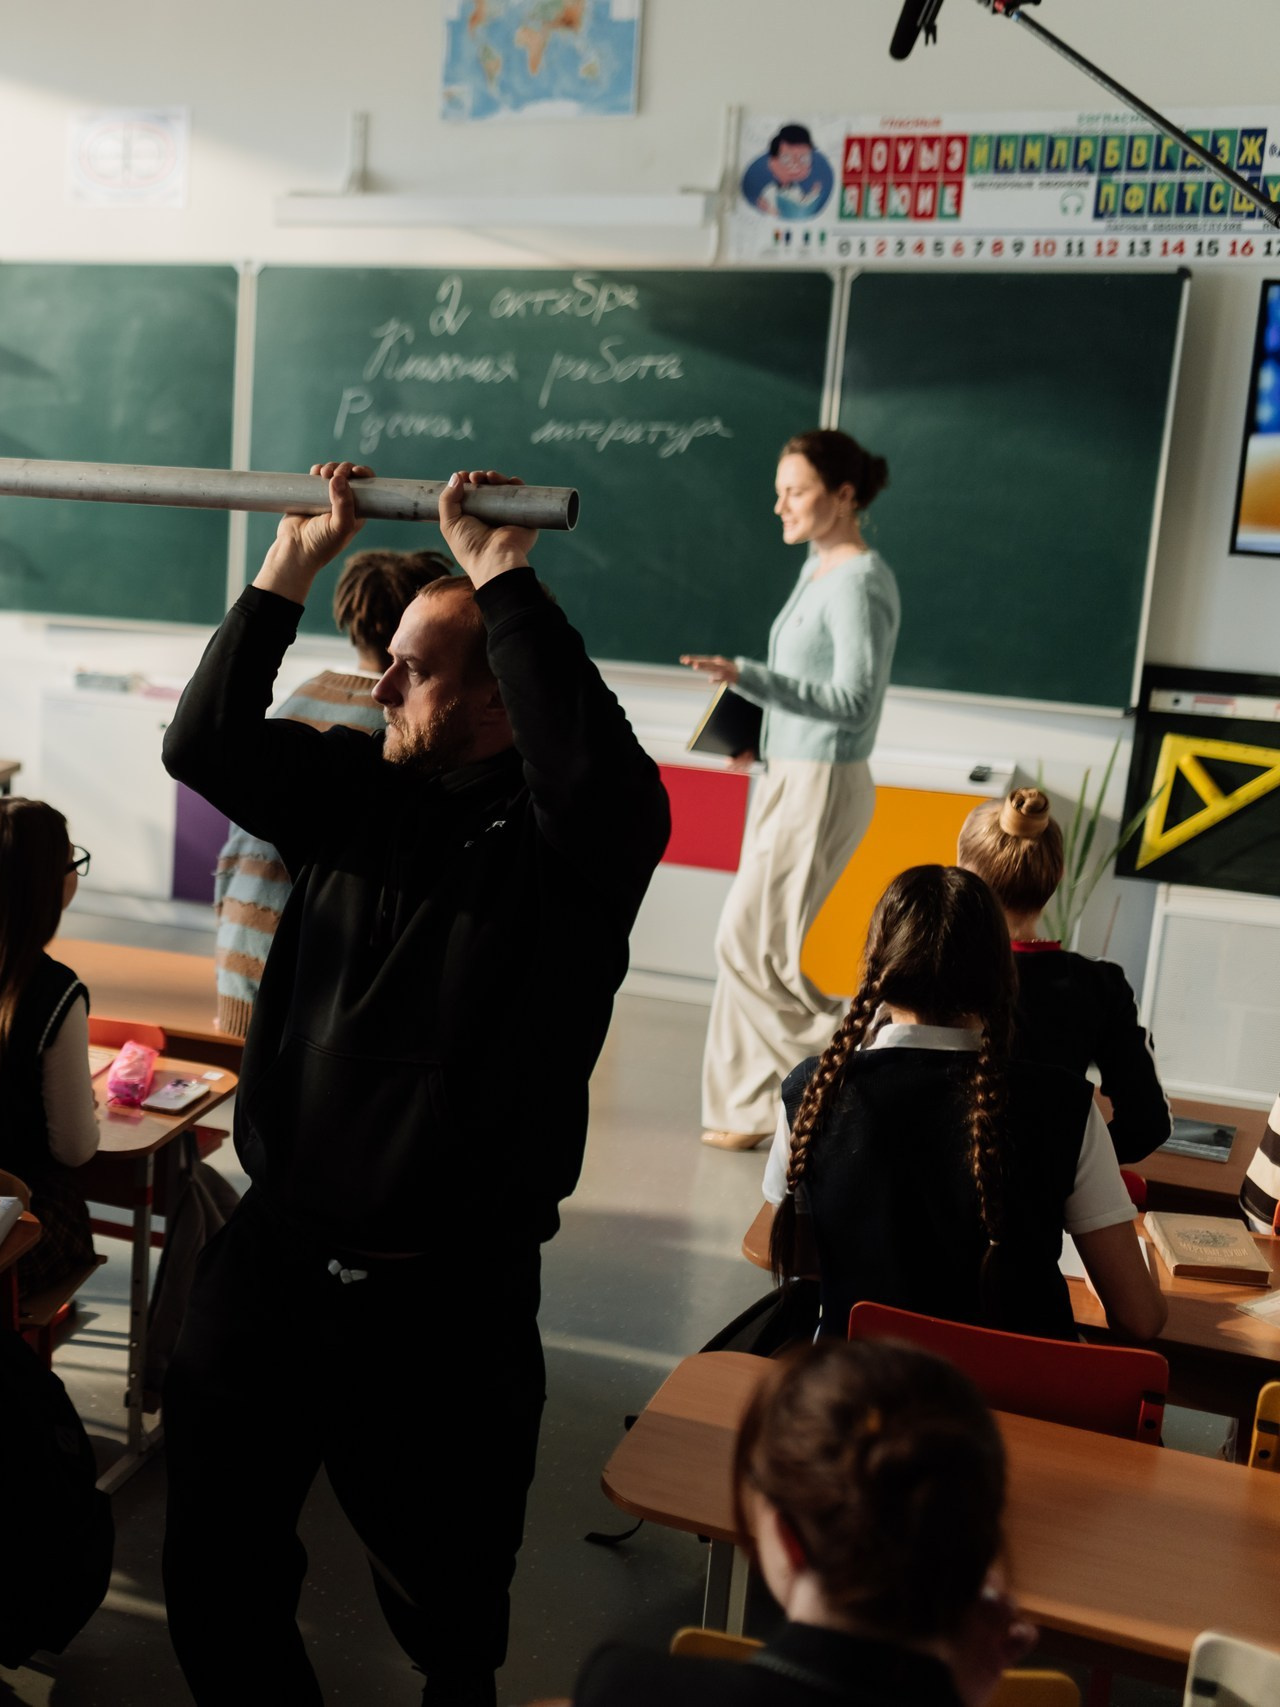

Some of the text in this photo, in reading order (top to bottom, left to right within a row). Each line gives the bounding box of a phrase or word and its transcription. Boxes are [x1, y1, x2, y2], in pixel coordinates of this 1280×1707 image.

[845, 140, 862, 173] А
[871, 139, 888, 172] О
[897, 139, 914, 172] У
[946, 138, 963, 172] Э
[1050, 139, 1068, 169] Л
[1077, 138, 1093, 168] Р
[1103, 138, 1120, 169] Б
[1130, 138, 1147, 169] В
[1159, 138, 1174, 168] Г
[1239, 134, 1264, 166] Ж
[1098, 184, 1117, 214] П
[1124, 183, 1144, 214] Ф
[1153, 183, 1169, 213] К
[1183, 183, 1197, 212] Т
[1209, 183, 1224, 213] С
[838, 239, 851, 257] 0
[858, 239, 866, 257] 1
[875, 239, 886, 257] 2
[894, 239, 906, 257] 3
[913, 239, 925, 257] 4
[933, 239, 945, 257] 5
[952, 239, 965, 257] 6
[973, 239, 984, 257] 7
[991, 239, 1004, 257] 8
[1012, 239, 1024, 257] 9
[1033, 239, 1057, 257] 10
[1065, 239, 1085, 257] 11
[1094, 239, 1119, 257] 12
[1128, 239, 1151, 257] 13
[1160, 239, 1185, 257] 14
[1194, 239, 1218, 257] 15
[1228, 239, 1254, 257] 16
[428, 273, 472, 336] 2
[538, 335, 684, 409] работа
